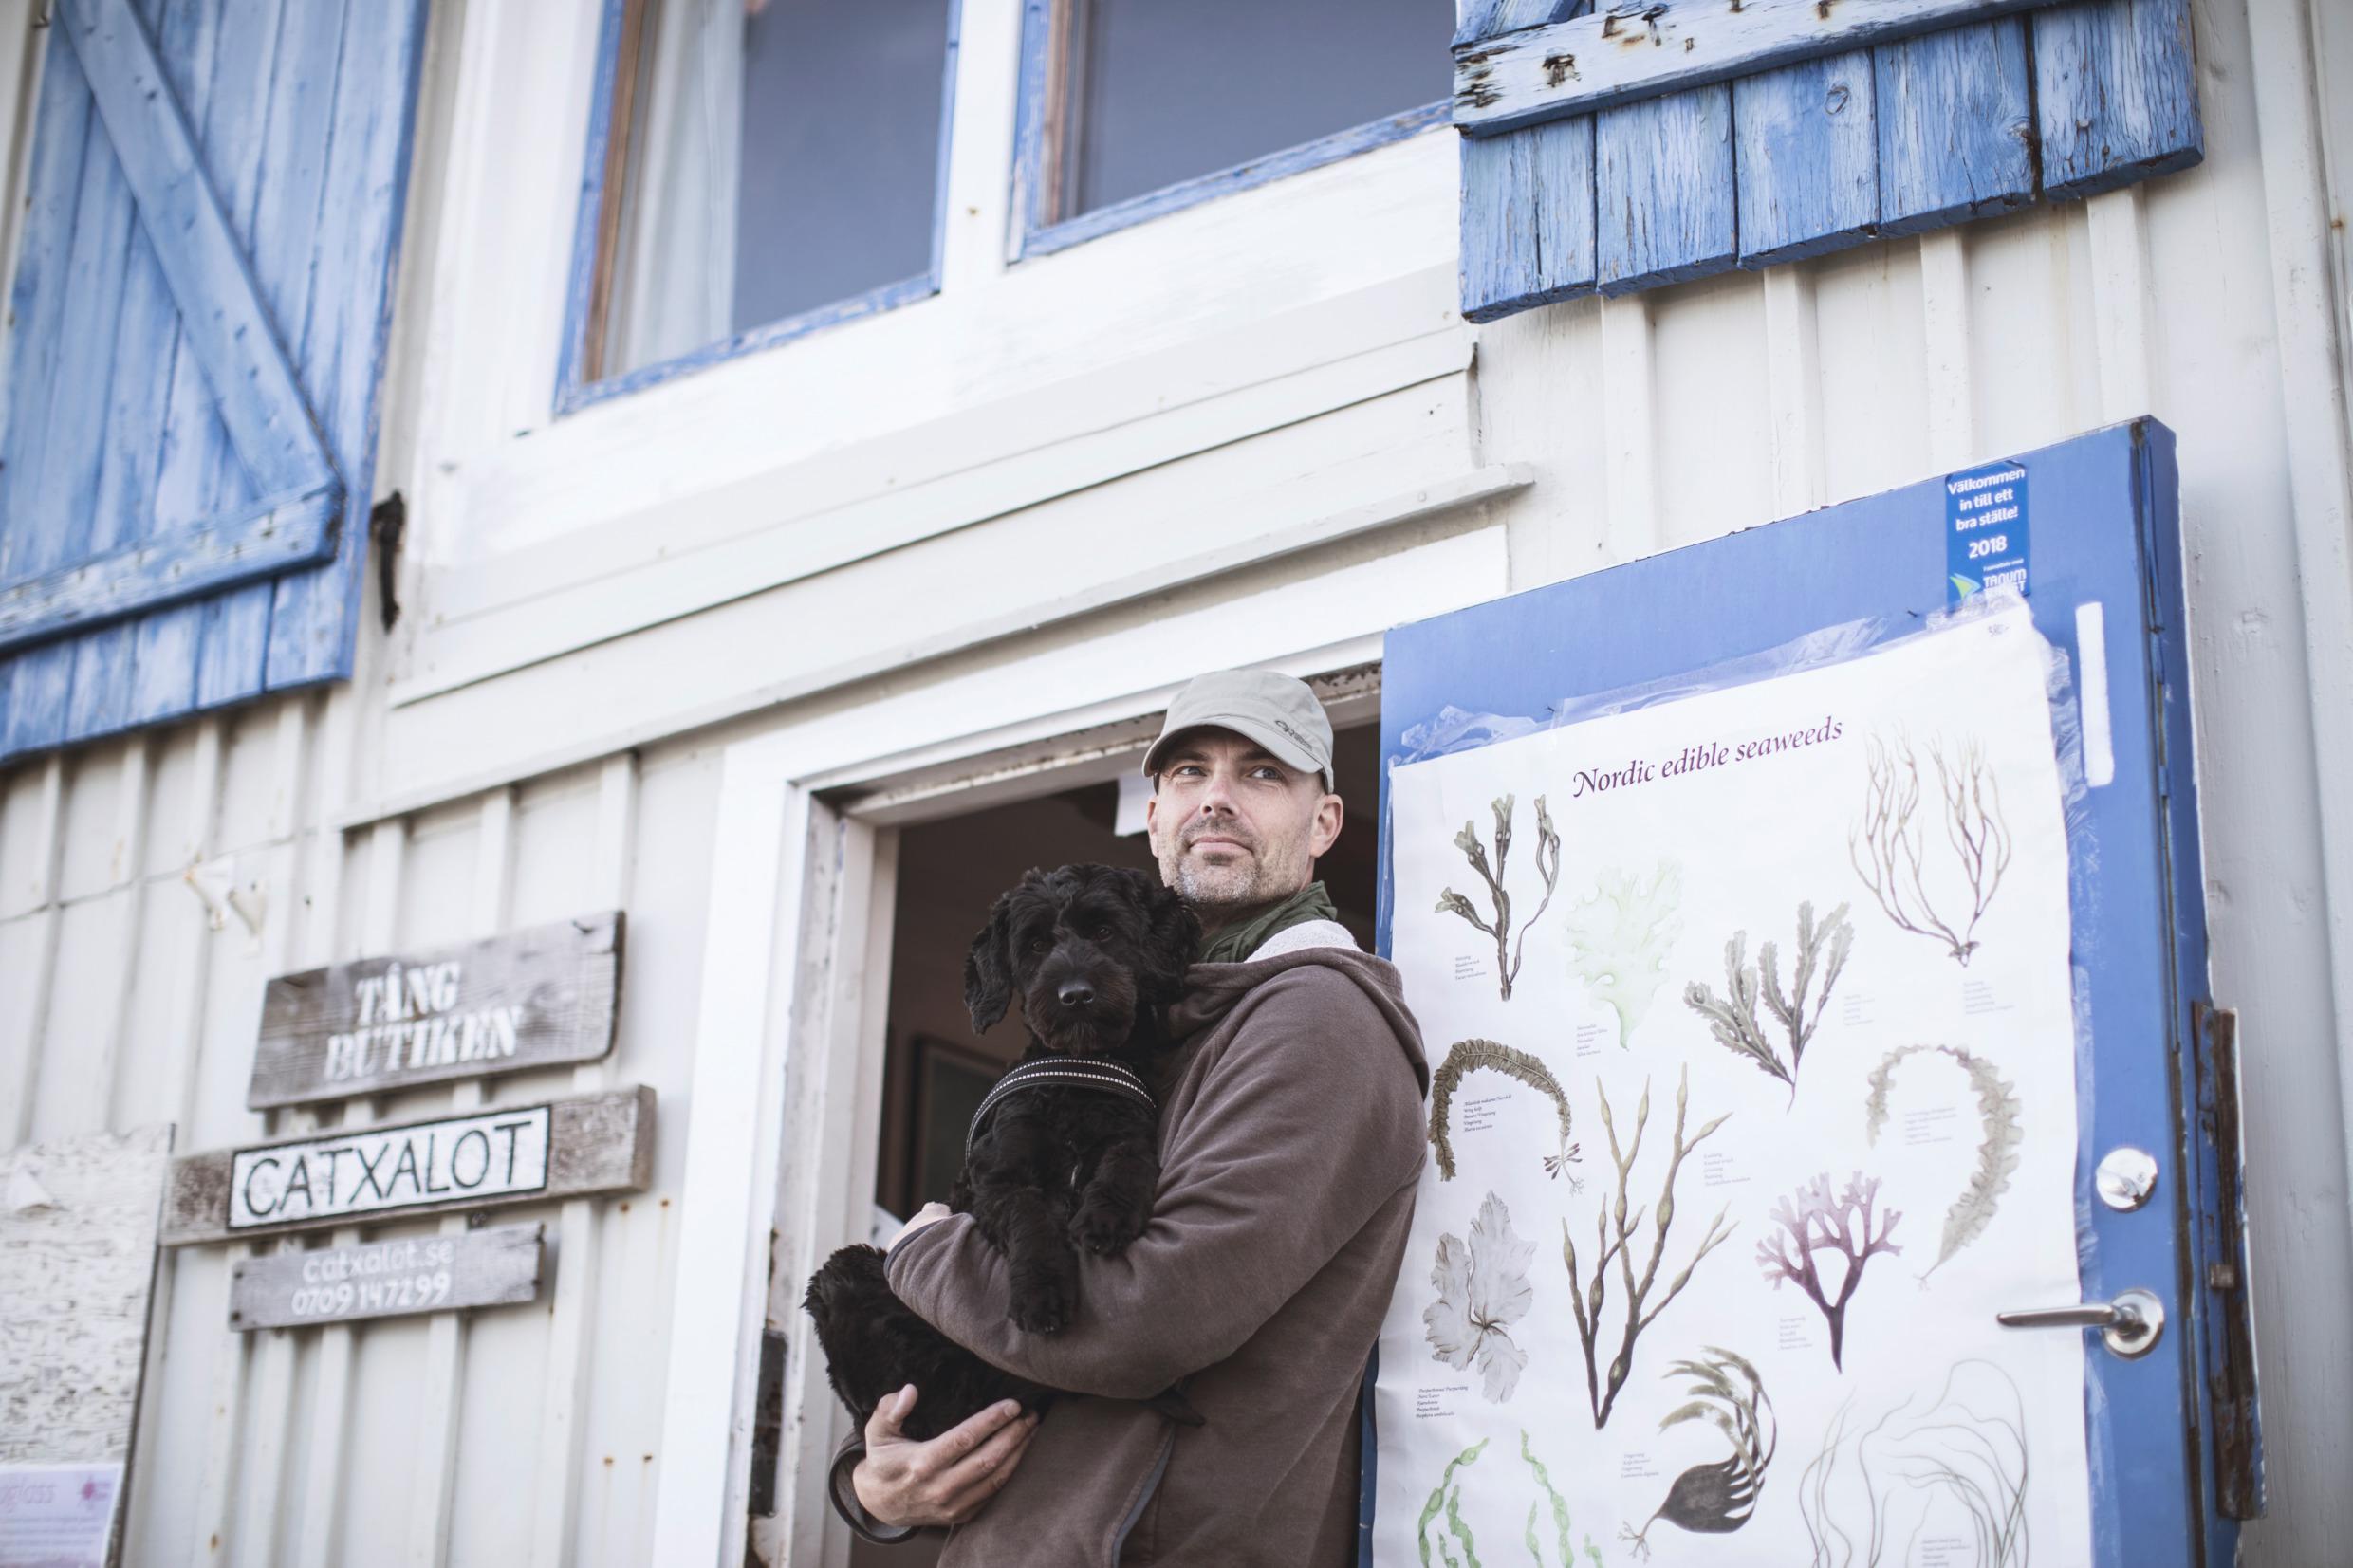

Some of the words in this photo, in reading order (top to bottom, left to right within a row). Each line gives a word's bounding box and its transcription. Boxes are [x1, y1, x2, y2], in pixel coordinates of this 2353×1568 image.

[1948, 468, 2026, 495] Välkommen
[1959, 498, 1973, 512] in
[1973, 492, 1993, 508] till
[1994, 488, 2014, 504] ett
[1955, 518, 1978, 532] bra
[1978, 506, 2019, 526] ställe!
[1968, 535, 2008, 560] 2018
[1572, 759, 1656, 798] Nordic
[1661, 741, 1730, 779] edible
[1734, 715, 1843, 763] seaweeds
[355, 961, 461, 1027] TÅNG
[324, 1005, 525, 1081] BUTIKEN
[243, 1120, 533, 1217] CATXALOT
[302, 1240, 454, 1282] catxalot.se
